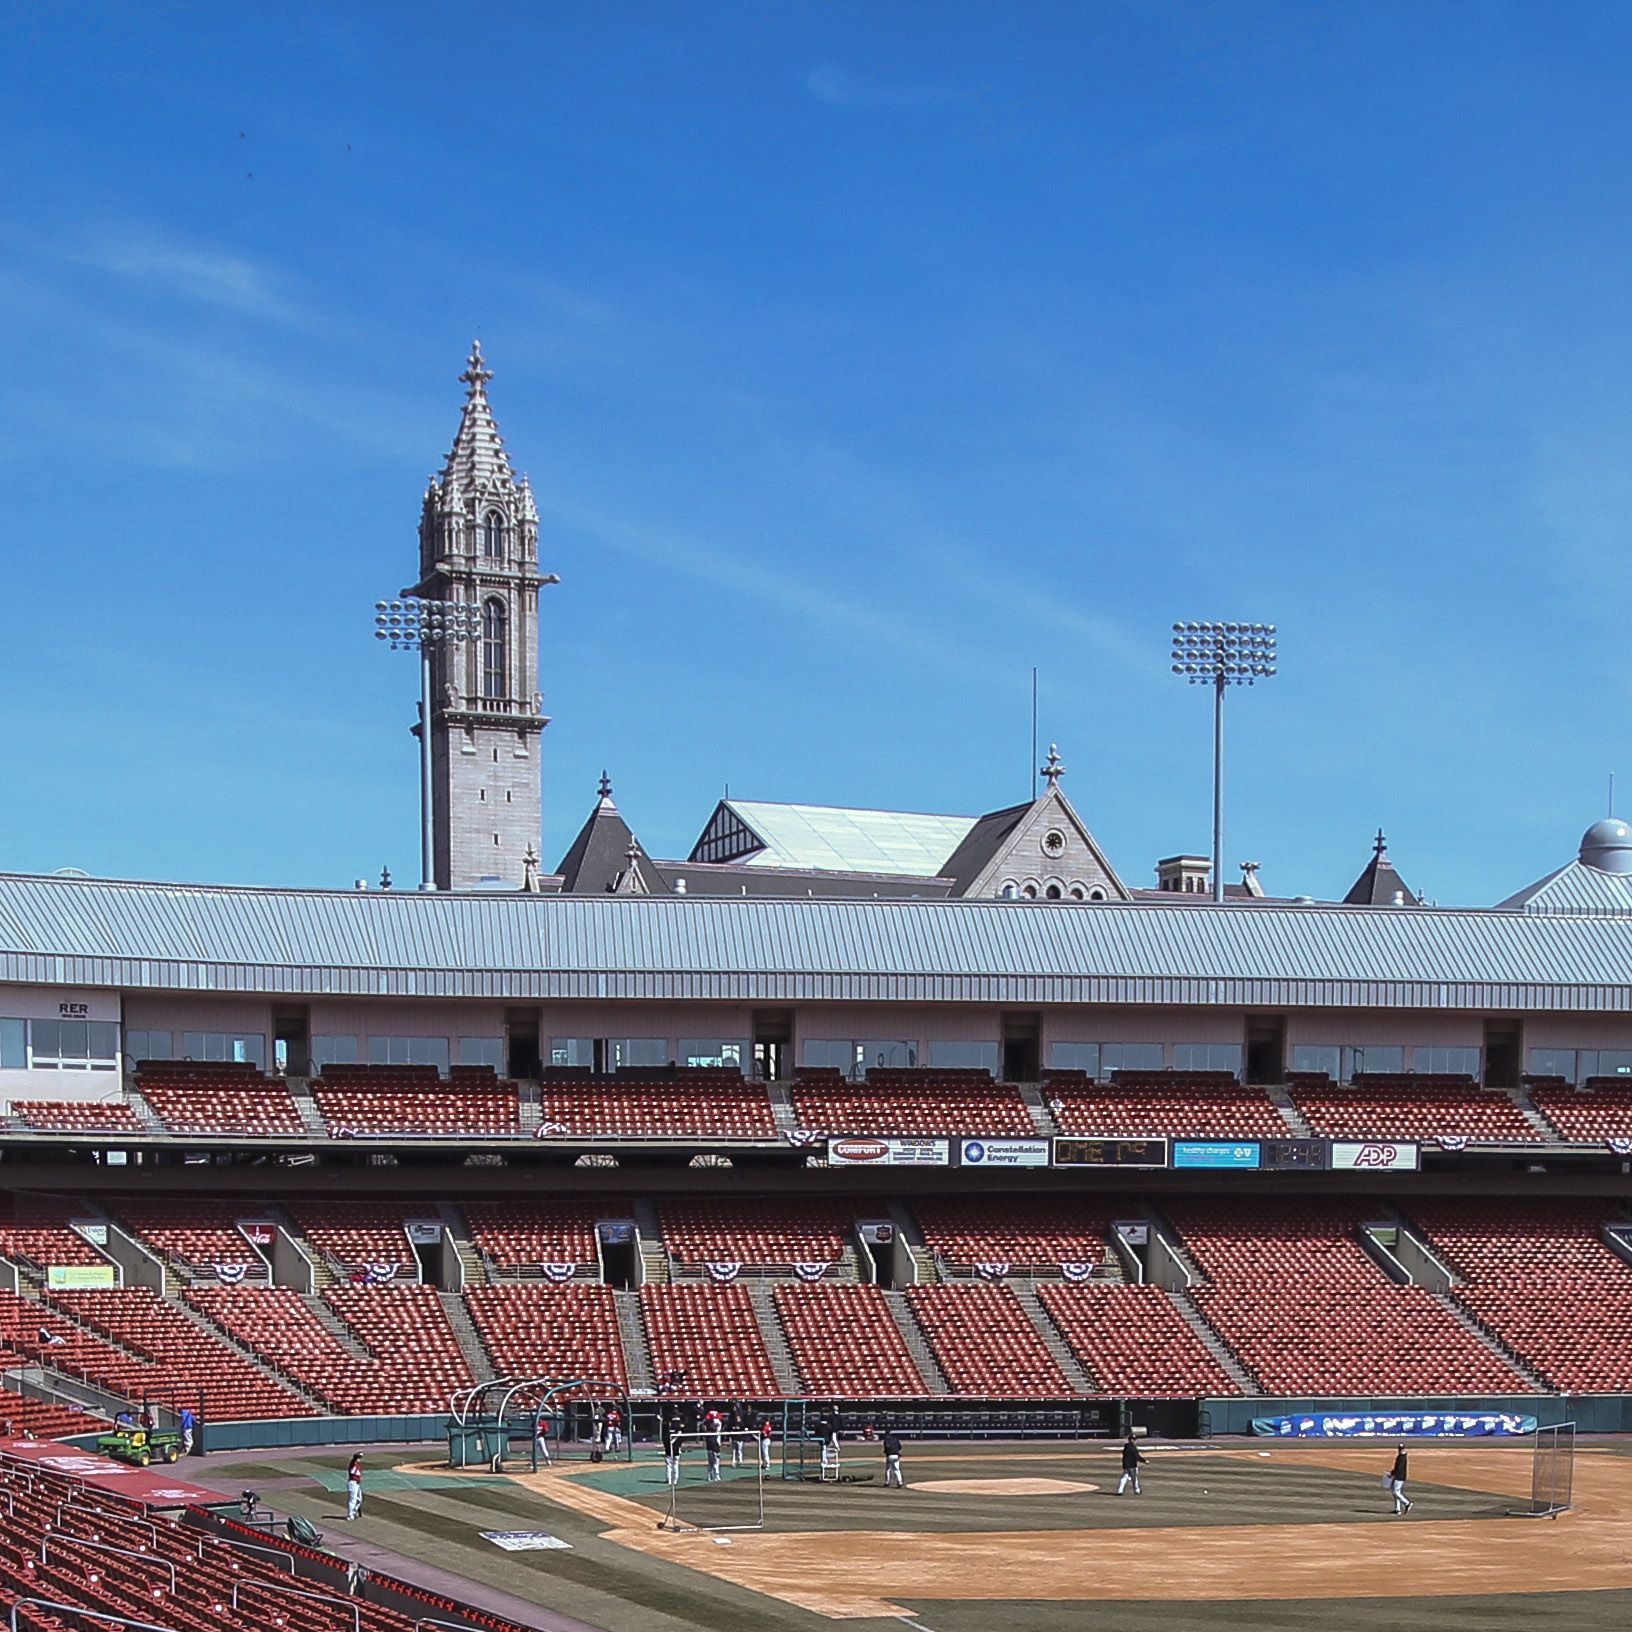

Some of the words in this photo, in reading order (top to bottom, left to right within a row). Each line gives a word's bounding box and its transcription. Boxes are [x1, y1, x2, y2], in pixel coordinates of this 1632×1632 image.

[59, 1003, 89, 1014] RER
[987, 1145, 1046, 1154] Constellation
[987, 1154, 1019, 1164] Energy
[1353, 1144, 1398, 1167] ADP
